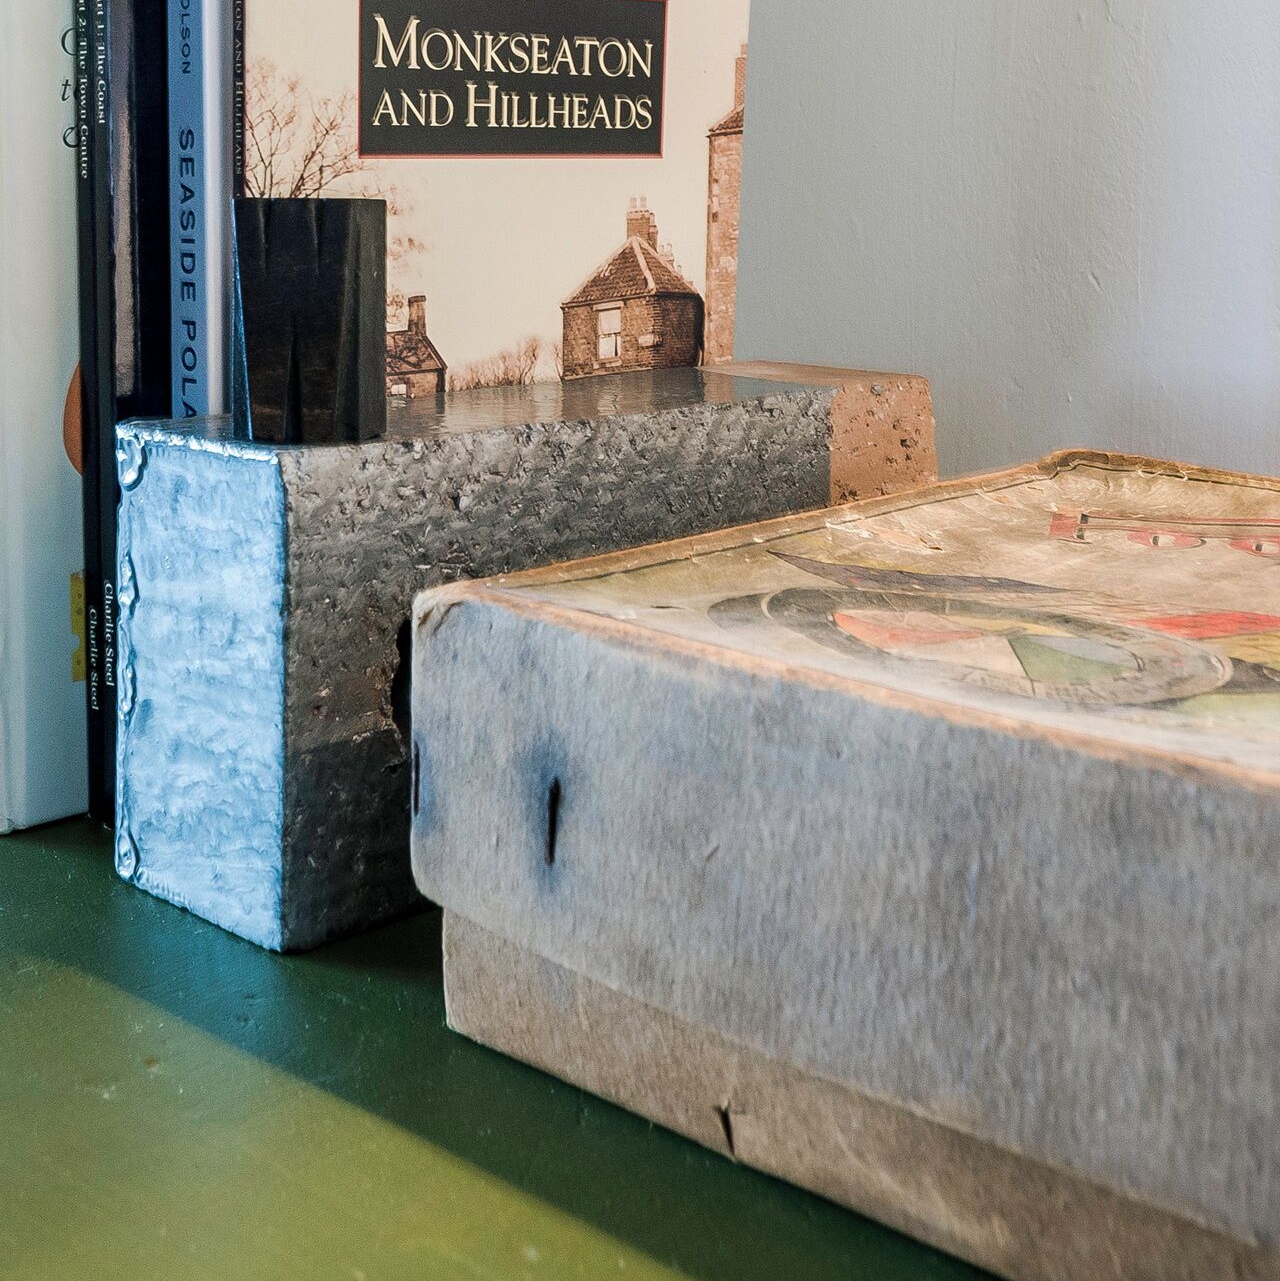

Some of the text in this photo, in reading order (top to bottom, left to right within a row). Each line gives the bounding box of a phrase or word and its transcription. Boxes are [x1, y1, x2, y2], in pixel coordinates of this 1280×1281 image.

[79, 37, 87, 70] The
[97, 42, 106, 75] The
[234, 38, 244, 74] AND
[373, 13, 653, 78] MONKSEATON
[80, 74, 88, 118] Town
[98, 79, 107, 124] Coast
[373, 81, 653, 131] AND HILLHEADS
[81, 124, 89, 179] Centre
[179, 128, 197, 304] SEASIDE
[89, 607, 100, 711] Charlie Steel
[105, 582, 115, 687] Charlie Steel
